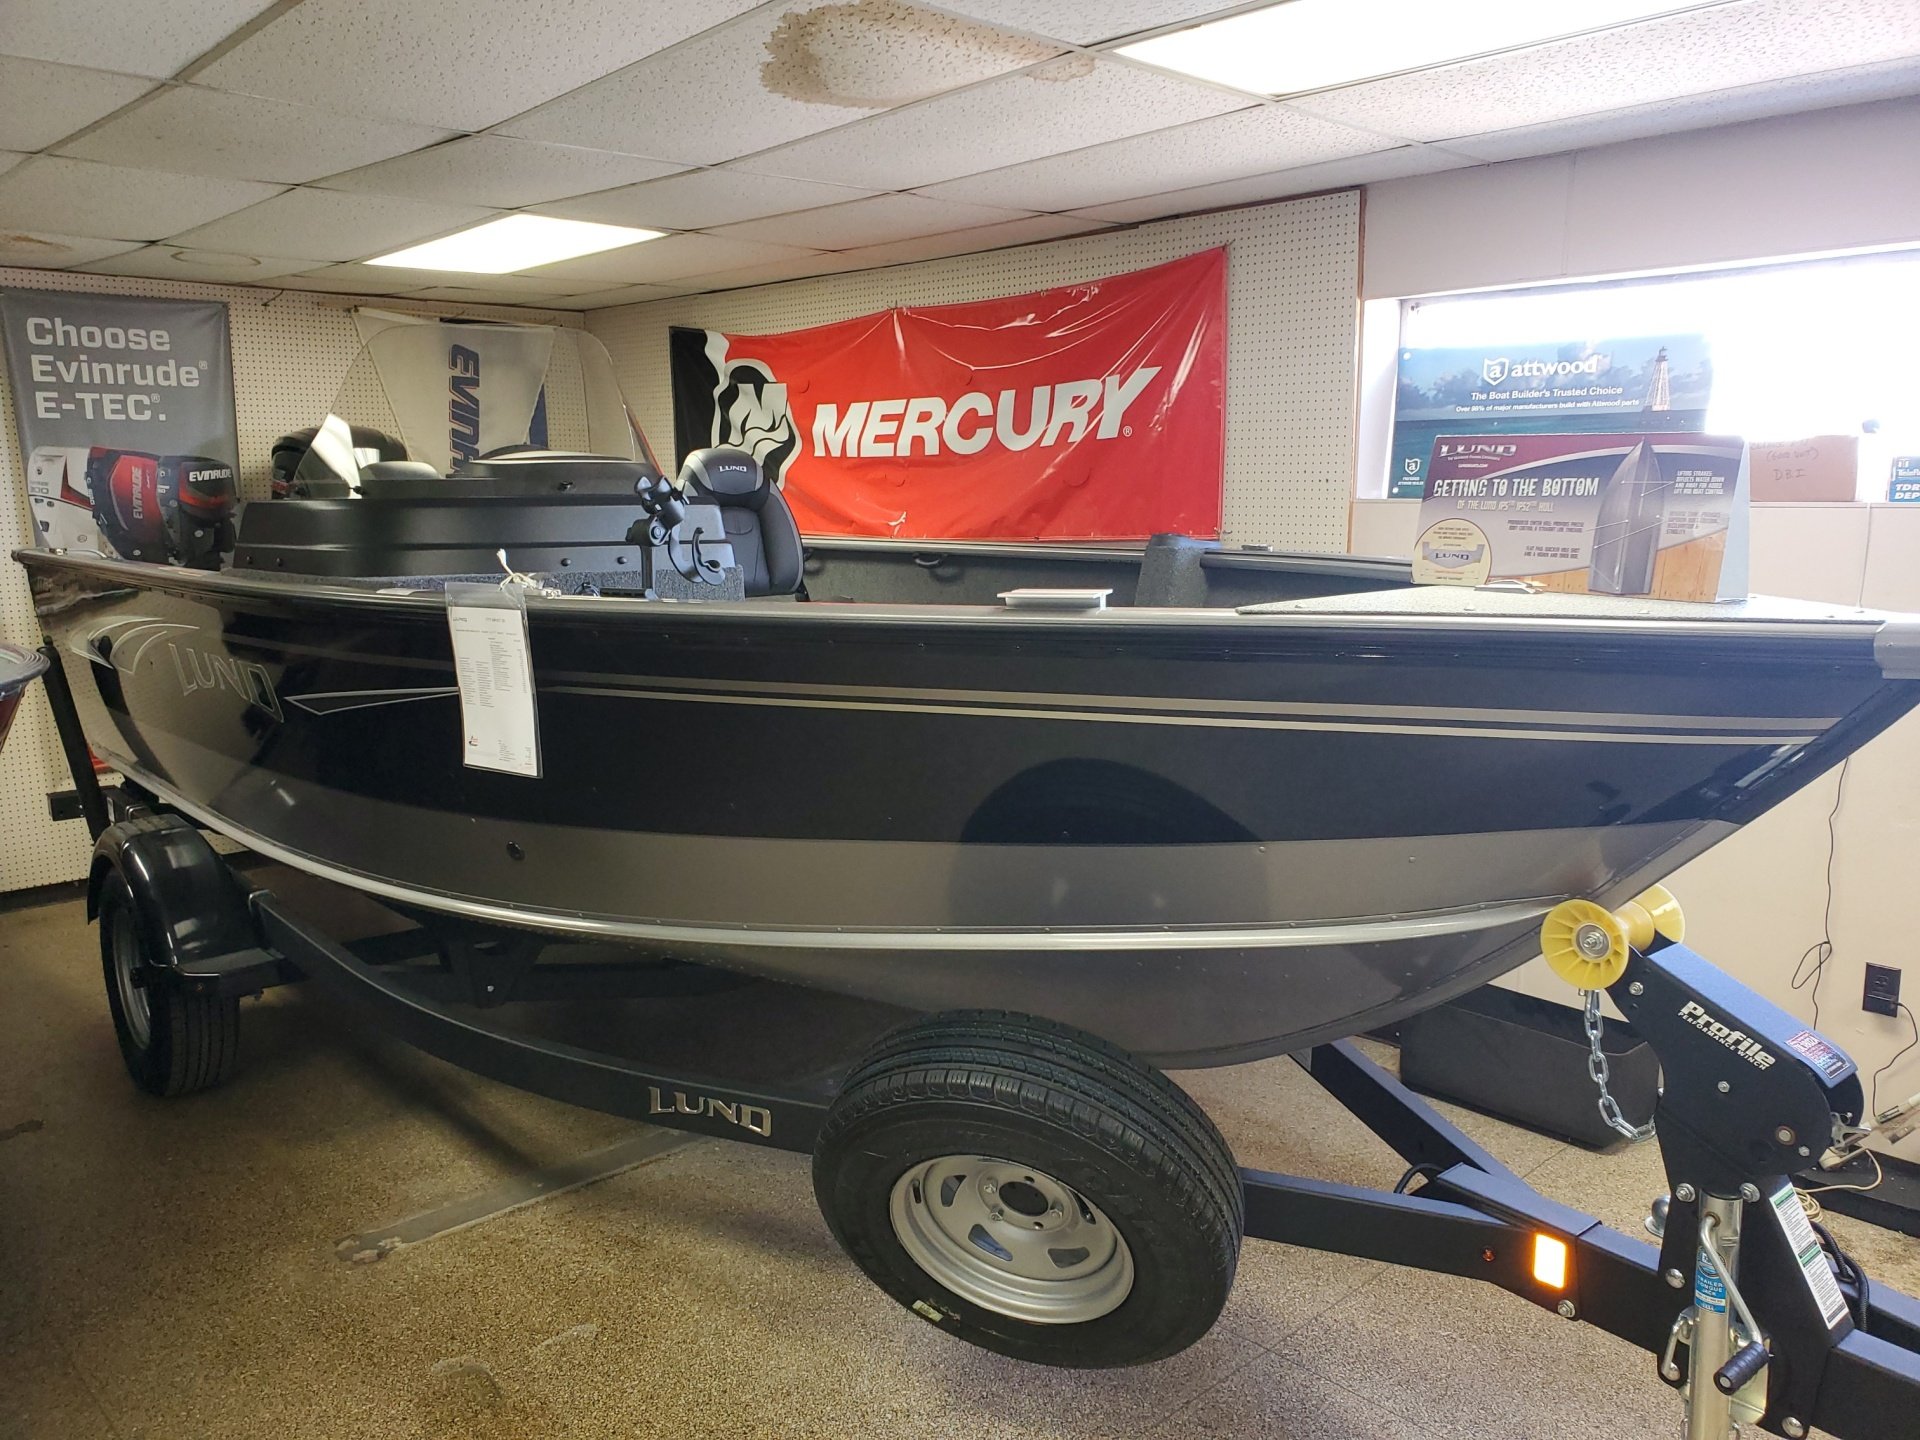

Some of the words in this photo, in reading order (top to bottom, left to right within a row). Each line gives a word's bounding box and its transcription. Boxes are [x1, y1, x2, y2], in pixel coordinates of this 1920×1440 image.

[26, 317, 170, 351] Choose
[1511, 354, 1600, 378] attwood
[449, 344, 480, 472] EVINR
[1470, 392, 1486, 401] The
[1489, 391, 1510, 400] Boat
[1512, 390, 1550, 399] Builder's
[1552, 388, 1587, 397] Trusted
[1589, 386, 1623, 396] Choice
[1494, 404, 1511, 412] major
[1512, 402, 1558, 410] manufacturers
[1559, 401, 1575, 409] build
[1576, 400, 1590, 408] with
[1622, 399, 1640, 408] parts
[1439, 444, 1517, 457] LUND
[189, 468, 232, 482] EVINRUDE
[1433, 479, 1488, 497] GETTING
[1492, 479, 1505, 496] TO
[1512, 478, 1538, 497] THE
[1542, 478, 1599, 496] BOTTOM
[132, 466, 143, 519] EVINRUDE
[1436, 552, 1469, 560] LUND
[168, 642, 284, 723] LUND
[1678, 1012, 1736, 1051] PERFORMANCE
[1737, 1050, 1767, 1070] WINCH
[1680, 1000, 1776, 1067] Profile
[648, 1086, 772, 1137] LUND
